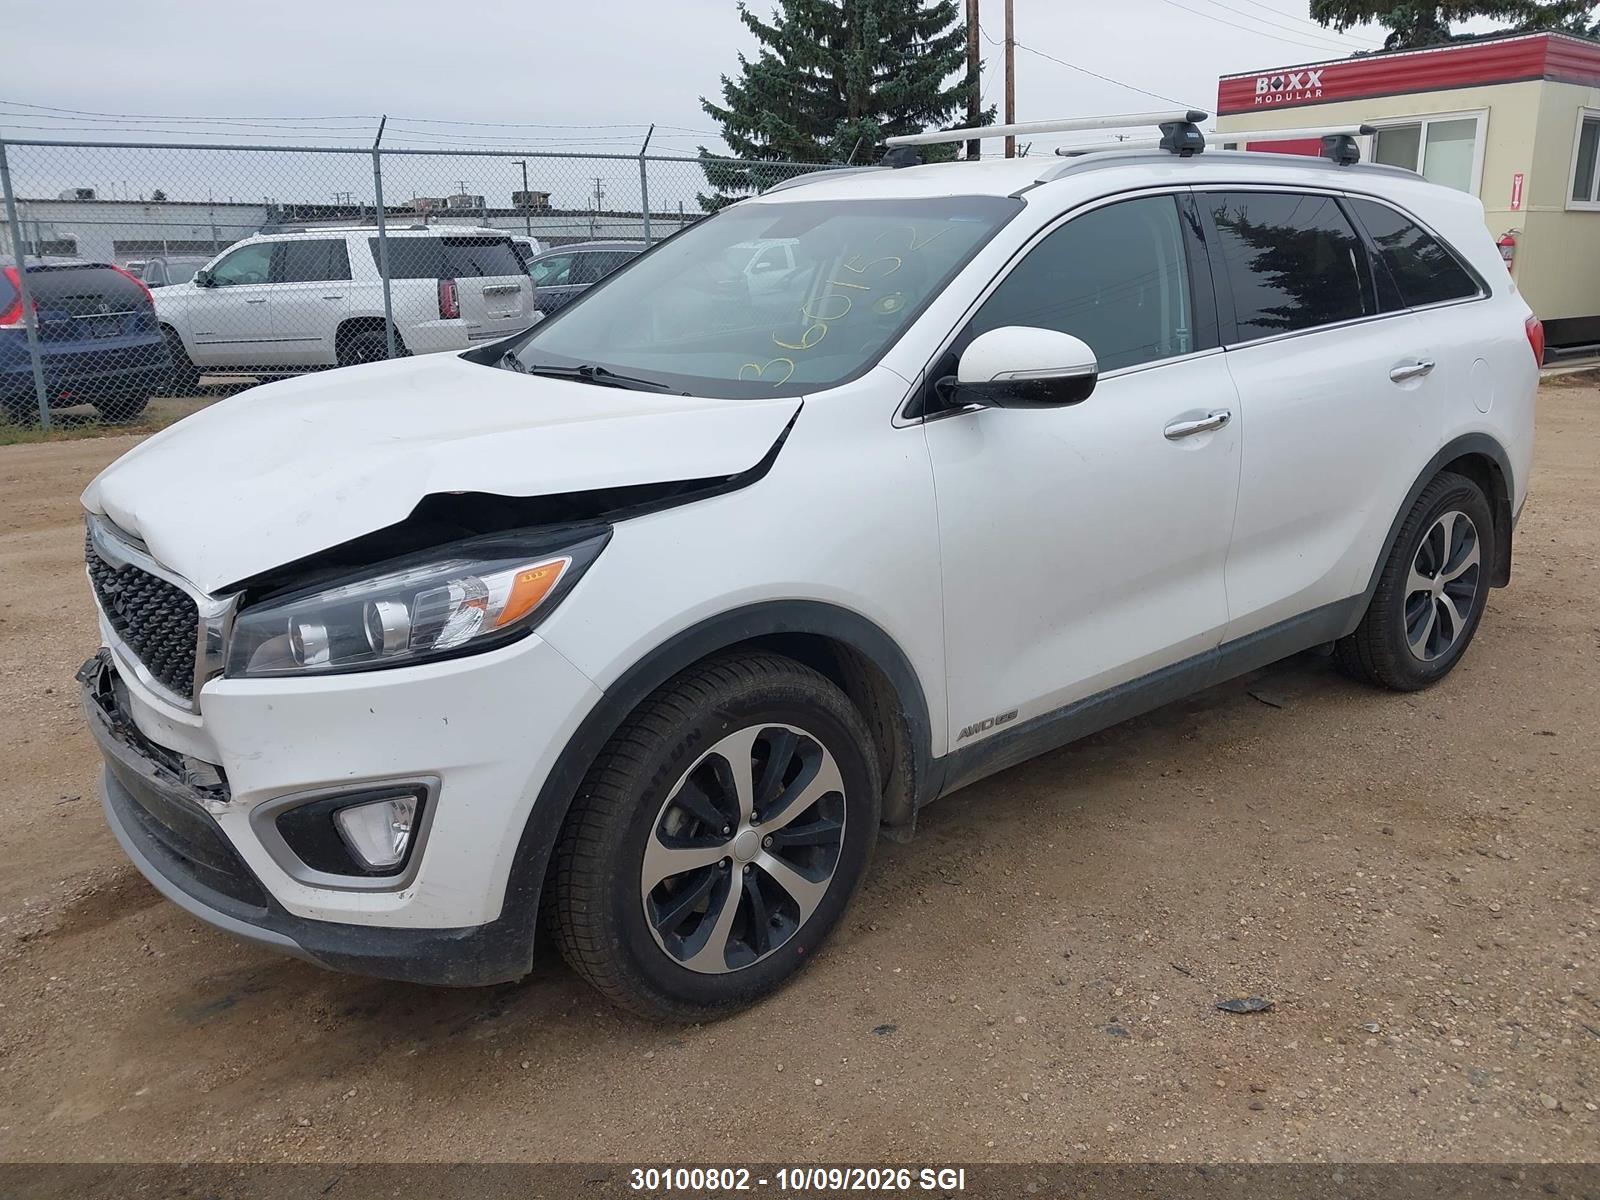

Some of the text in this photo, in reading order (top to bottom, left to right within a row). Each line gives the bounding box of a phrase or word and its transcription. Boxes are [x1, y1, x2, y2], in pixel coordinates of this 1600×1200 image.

[1256, 70, 1323, 95] BOXX
[1255, 90, 1321, 104] MODULAR
[956, 716, 994, 741] AWD
